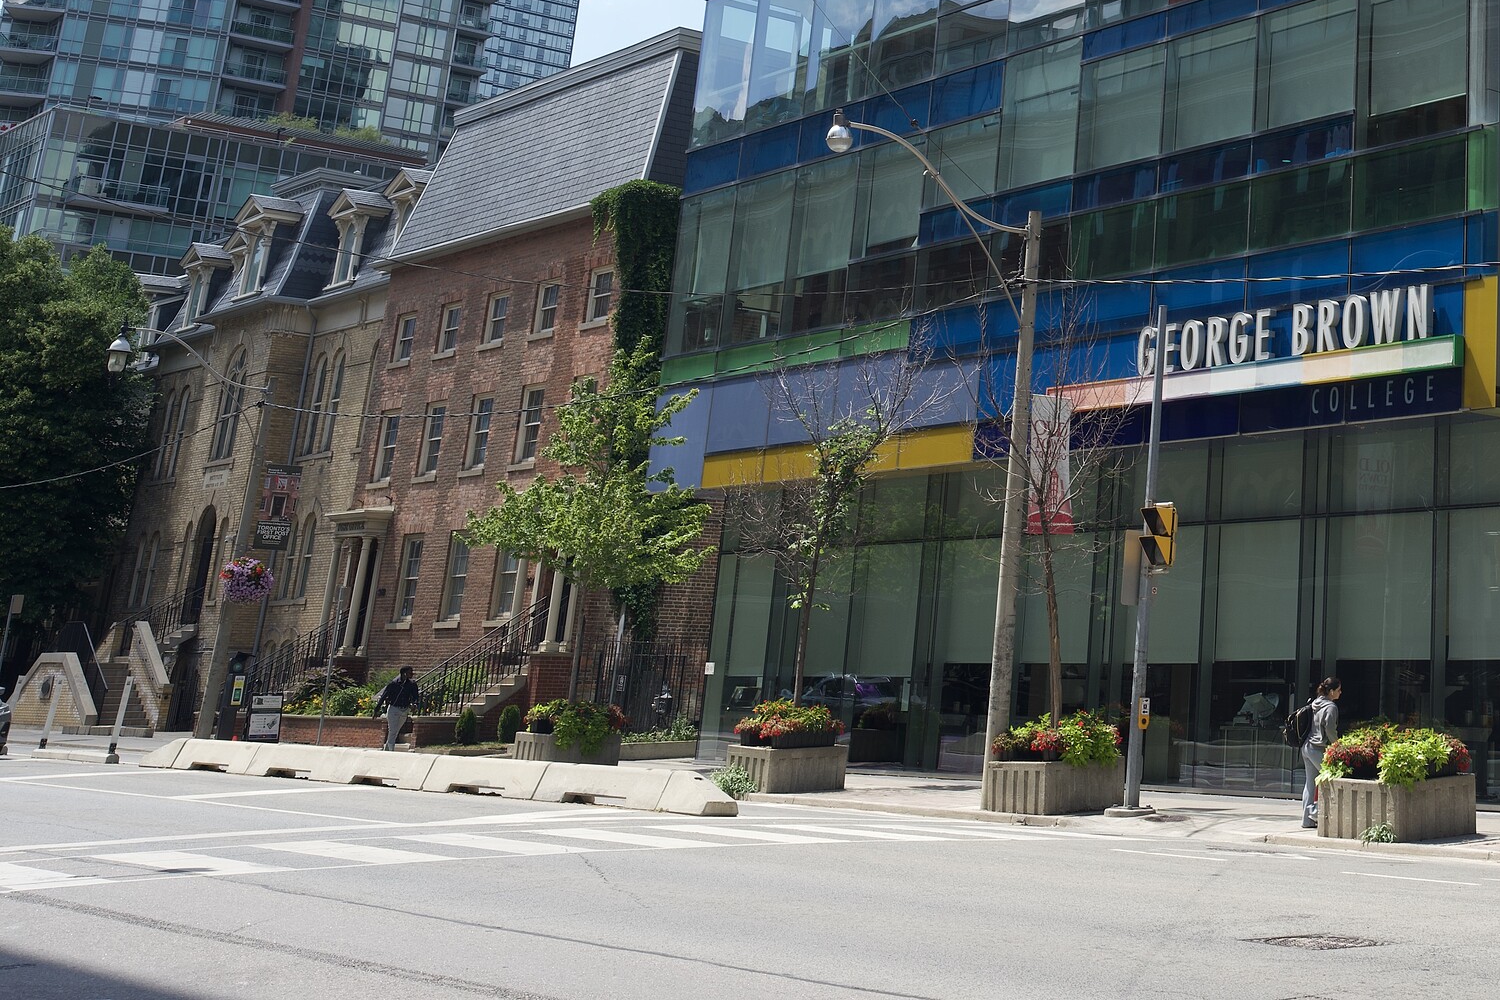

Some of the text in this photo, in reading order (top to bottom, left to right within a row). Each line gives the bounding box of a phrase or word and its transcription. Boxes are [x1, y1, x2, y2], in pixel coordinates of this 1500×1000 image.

[1137, 284, 1434, 377] GEORGE BROWN
[1311, 376, 1434, 414] COLLEGE
[256, 525, 291, 533] TORONTO'S
